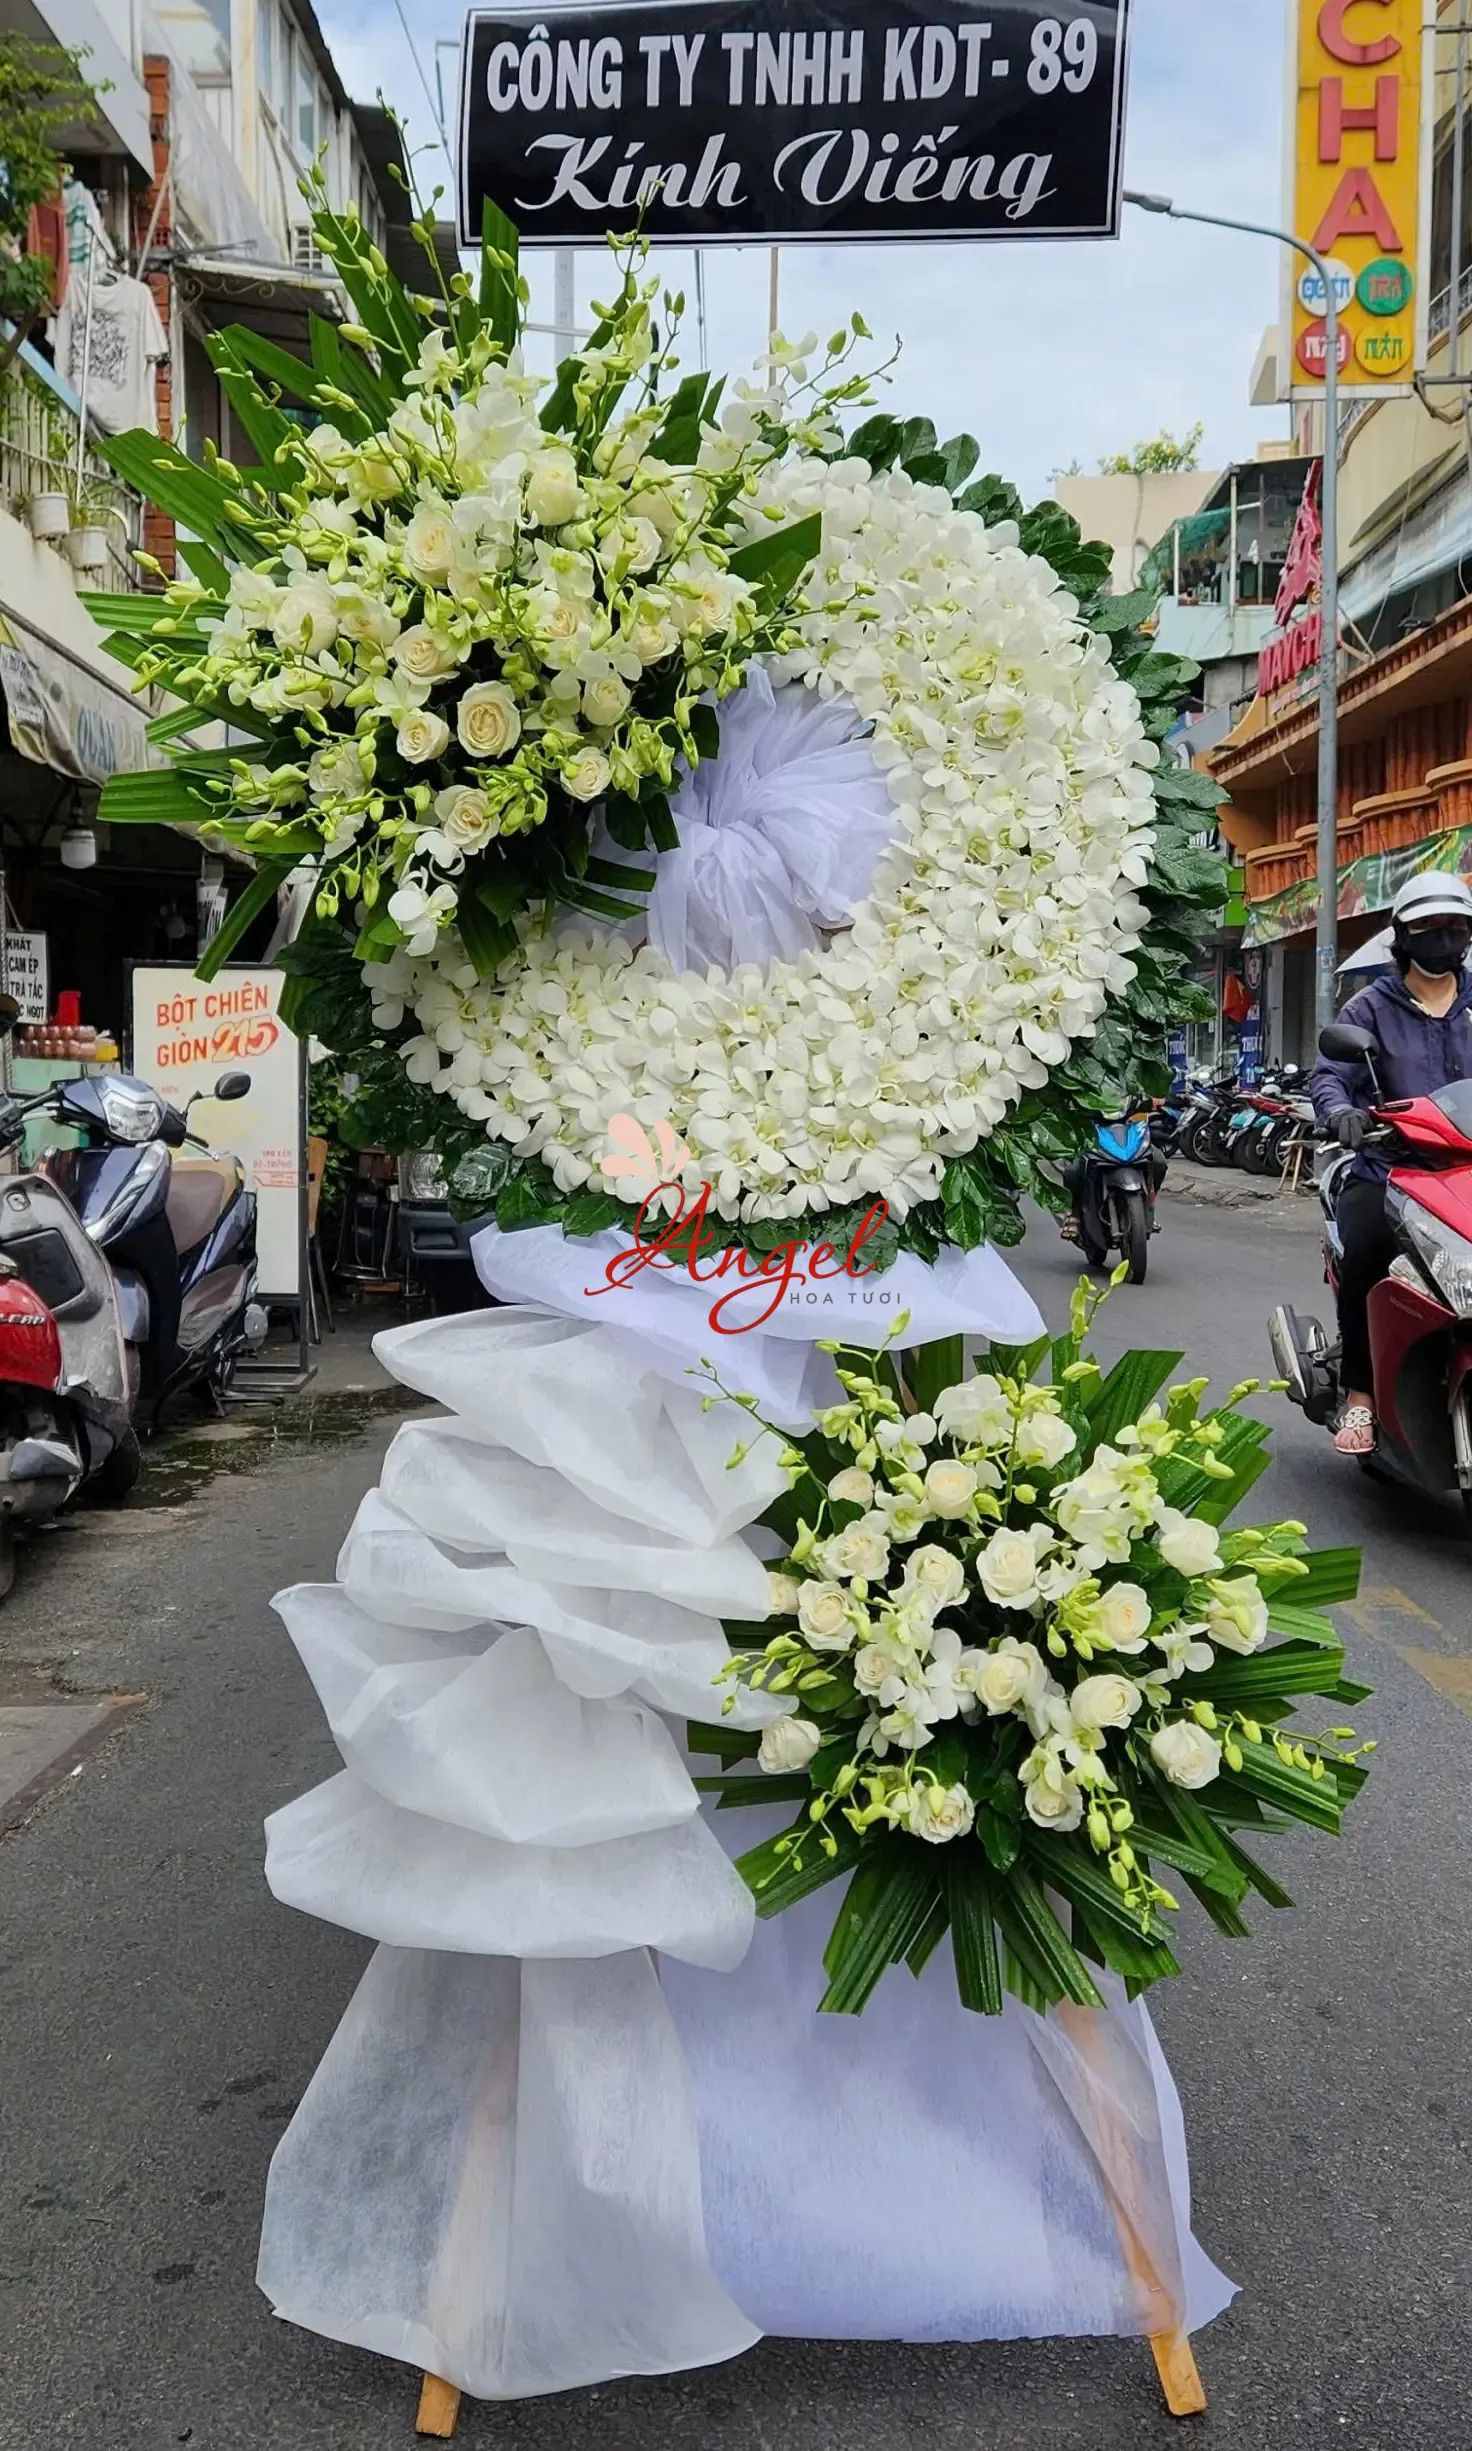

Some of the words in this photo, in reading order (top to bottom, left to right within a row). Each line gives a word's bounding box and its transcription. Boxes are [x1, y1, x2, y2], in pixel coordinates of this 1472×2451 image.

[486, 24, 622, 111] CÔNG
[639, 34, 707, 107] TY
[721, 30, 864, 104] TNHH
[1026, 18, 1097, 95] 89
[515, 133, 747, 210] Kính
[772, 125, 1058, 220] Viếng
[9, 957, 26, 973] CAM
[156, 993, 198, 1031] BỘT
[205, 981, 268, 1018] CHIÊN
[211, 1014, 279, 1063] 215
